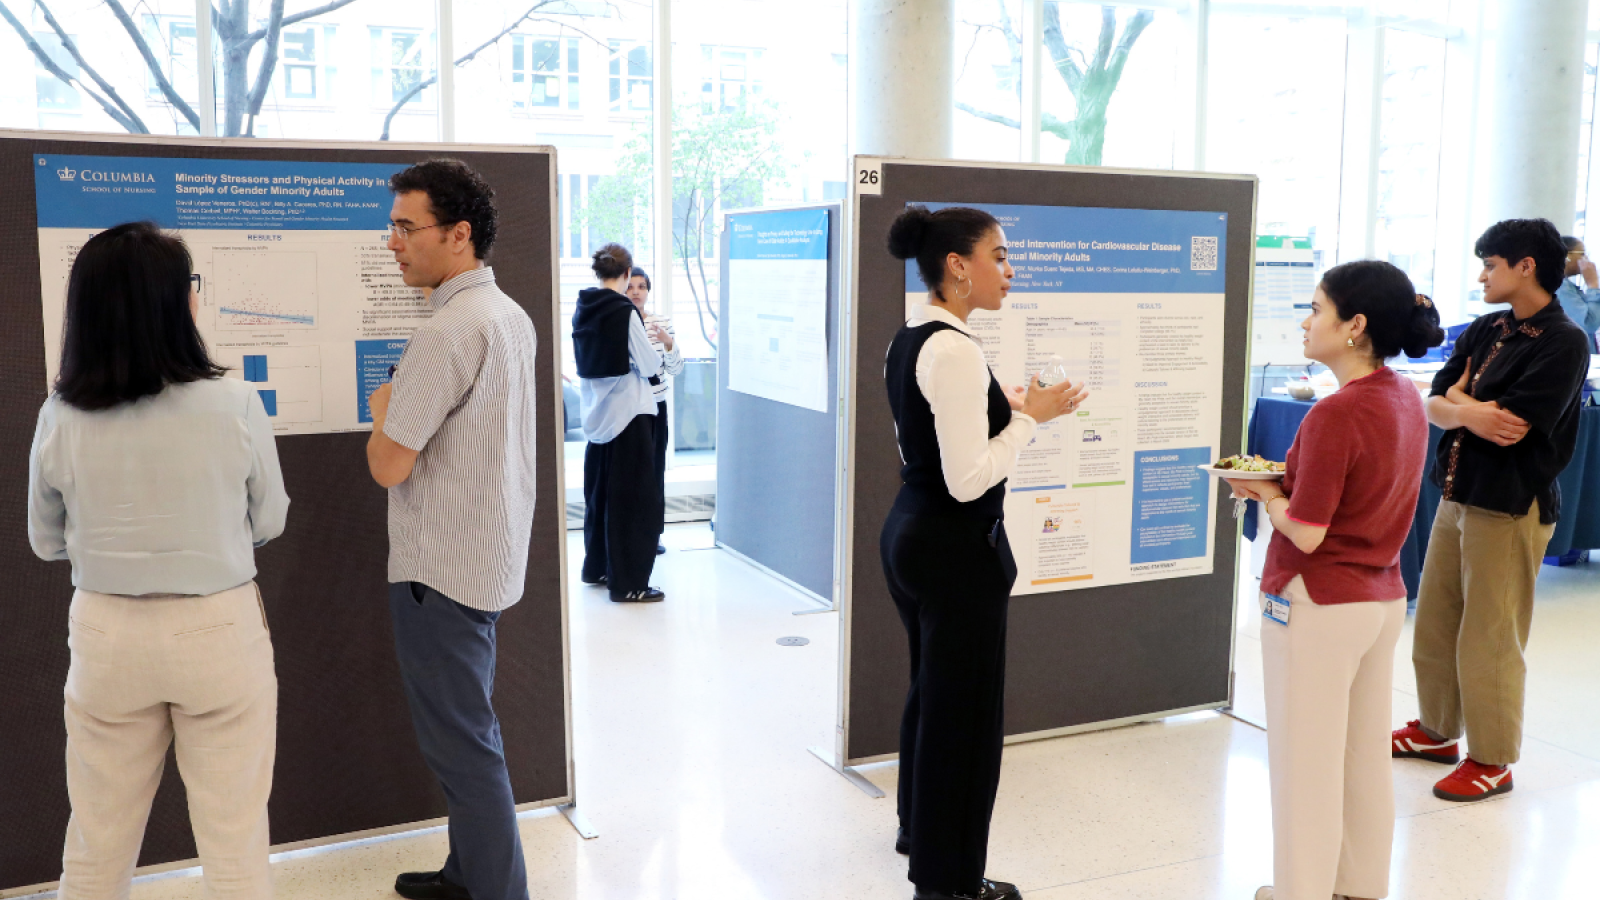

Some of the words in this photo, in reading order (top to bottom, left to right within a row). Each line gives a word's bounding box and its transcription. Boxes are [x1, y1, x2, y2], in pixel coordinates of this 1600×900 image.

[80, 170, 156, 182] COLUMBIA
[175, 173, 217, 185] Minority
[220, 174, 270, 184] Stressors
[272, 175, 291, 184] and
[294, 176, 335, 186] Physical
[337, 176, 373, 187] Activity
[376, 177, 385, 186] in
[860, 170, 878, 184] 26
[175, 184, 214, 196] Sample
[217, 186, 228, 194] of
[230, 186, 268, 194] Gender
[270, 186, 310, 197] Minority
[313, 187, 345, 196] Adults
[1006, 239, 1025, 248] ored
[1027, 239, 1076, 249] Intervention
[1078, 240, 1090, 250] for
[1091, 240, 1150, 251] Cardiovascular
[1151, 242, 1181, 252] Disease
[1007, 252, 1027, 260] exual
[1029, 252, 1063, 263] Minority
[1064, 253, 1090, 262] Adults
[1140, 455, 1179, 463] CONCLUSIONS
